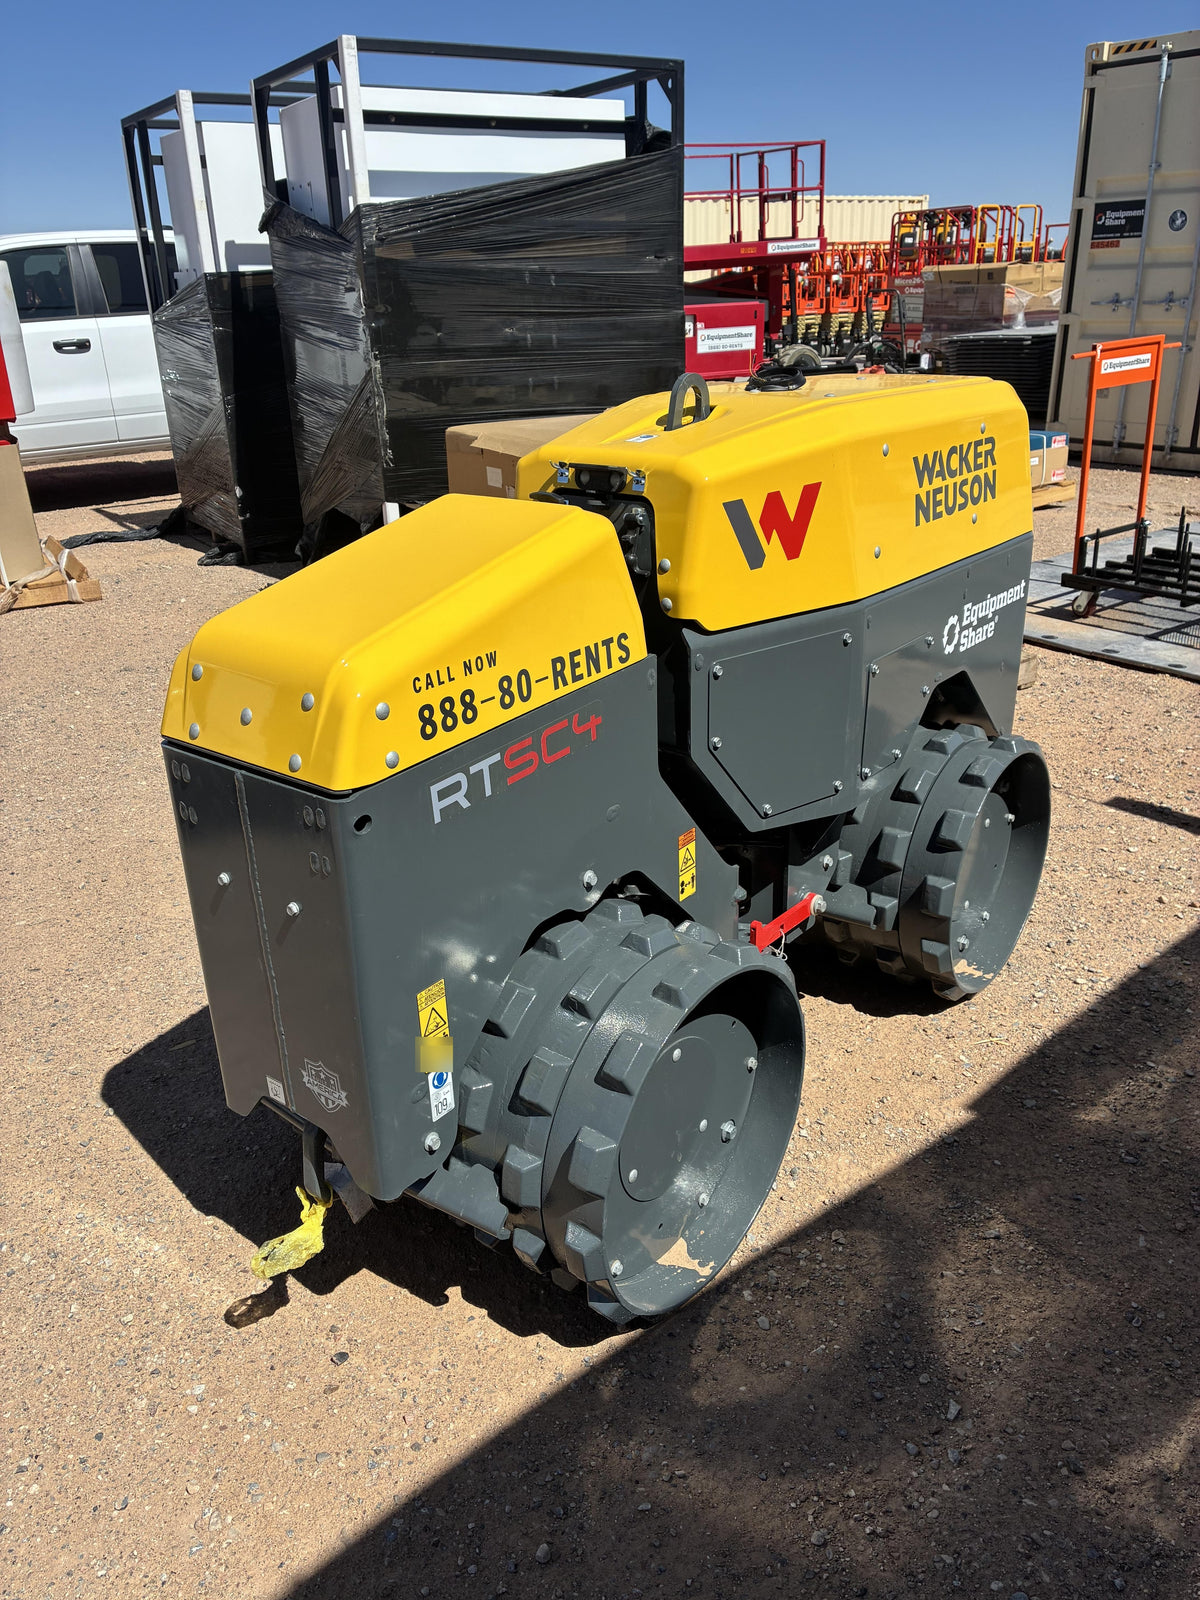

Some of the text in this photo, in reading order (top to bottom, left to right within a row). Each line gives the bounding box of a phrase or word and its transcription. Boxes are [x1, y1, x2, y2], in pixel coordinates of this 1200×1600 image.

[1105, 209, 1145, 219] Equipment
[776, 242, 816, 251] EquipmentShare
[706, 332, 753, 341] EquipmentShare
[1109, 358, 1150, 370] EquipmentShare
[912, 436, 997, 489] WACKER
[915, 469, 997, 527] NEUSON
[962, 579, 1026, 627] Equipment
[412, 650, 497, 694] CALL NOW
[418, 632, 631, 741] 888-80-RENTS
[434, 1098, 448, 1116] 109
